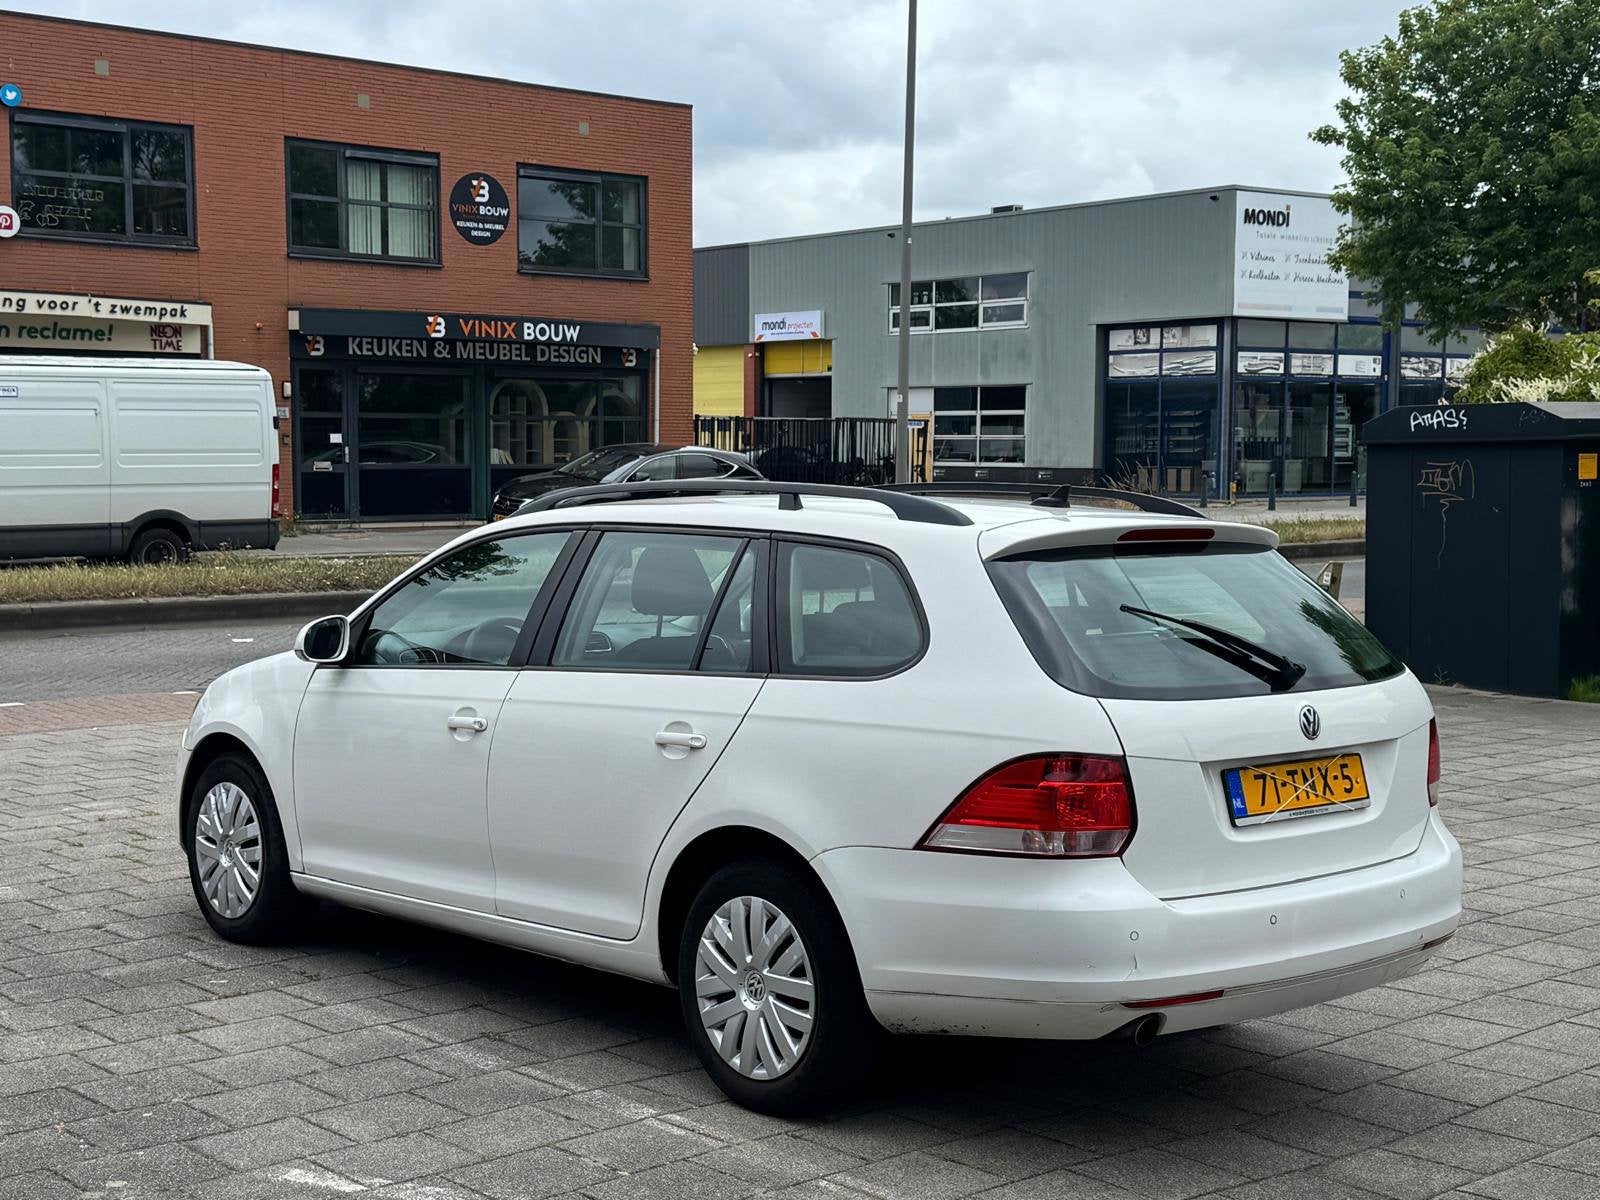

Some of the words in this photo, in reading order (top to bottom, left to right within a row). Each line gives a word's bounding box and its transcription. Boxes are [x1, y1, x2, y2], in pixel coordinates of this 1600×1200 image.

[452, 204, 477, 214] VINIX
[480, 206, 508, 216] BOUW
[37, 300, 78, 311] voor
[88, 299, 101, 312] 't
[110, 304, 188, 320] zwempak
[18, 322, 114, 342] reclame!
[150, 325, 182, 338] NEON
[460, 318, 517, 339] VINIX
[523, 322, 581, 342] BOUW
[762, 318, 786, 330] mondi
[151, 339, 182, 350] TIME
[348, 337, 427, 357] KEUKEN
[434, 341, 450, 358] &
[456, 342, 530, 361] MEUBEL
[536, 345, 601, 363] DESIGN
[1233, 798, 1245, 809] NL
[1254, 763, 1354, 806] 71-TNX-5
